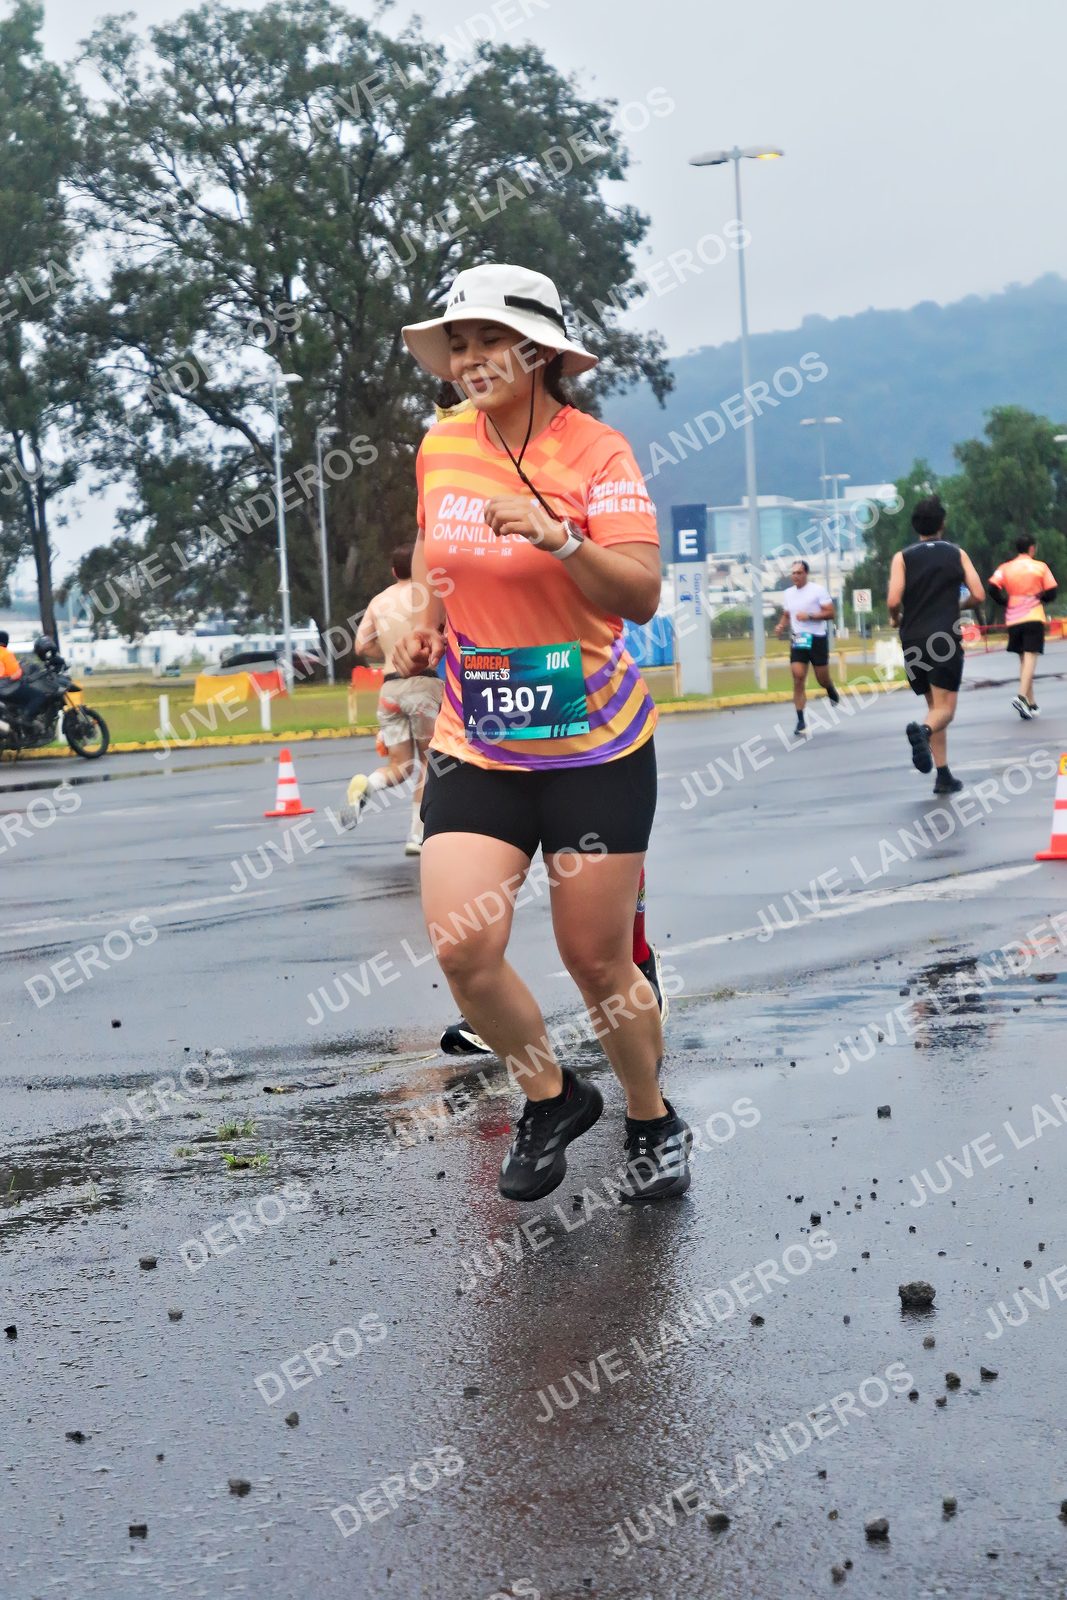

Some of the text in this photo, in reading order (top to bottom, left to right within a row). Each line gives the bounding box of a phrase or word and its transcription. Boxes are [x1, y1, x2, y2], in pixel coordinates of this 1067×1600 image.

[678, 529, 698, 556] E
[464, 655, 509, 671] CARRERA
[545, 650, 571, 671] 10K
[464, 670, 500, 681] OMNILIFE
[481, 684, 554, 713] 1307
